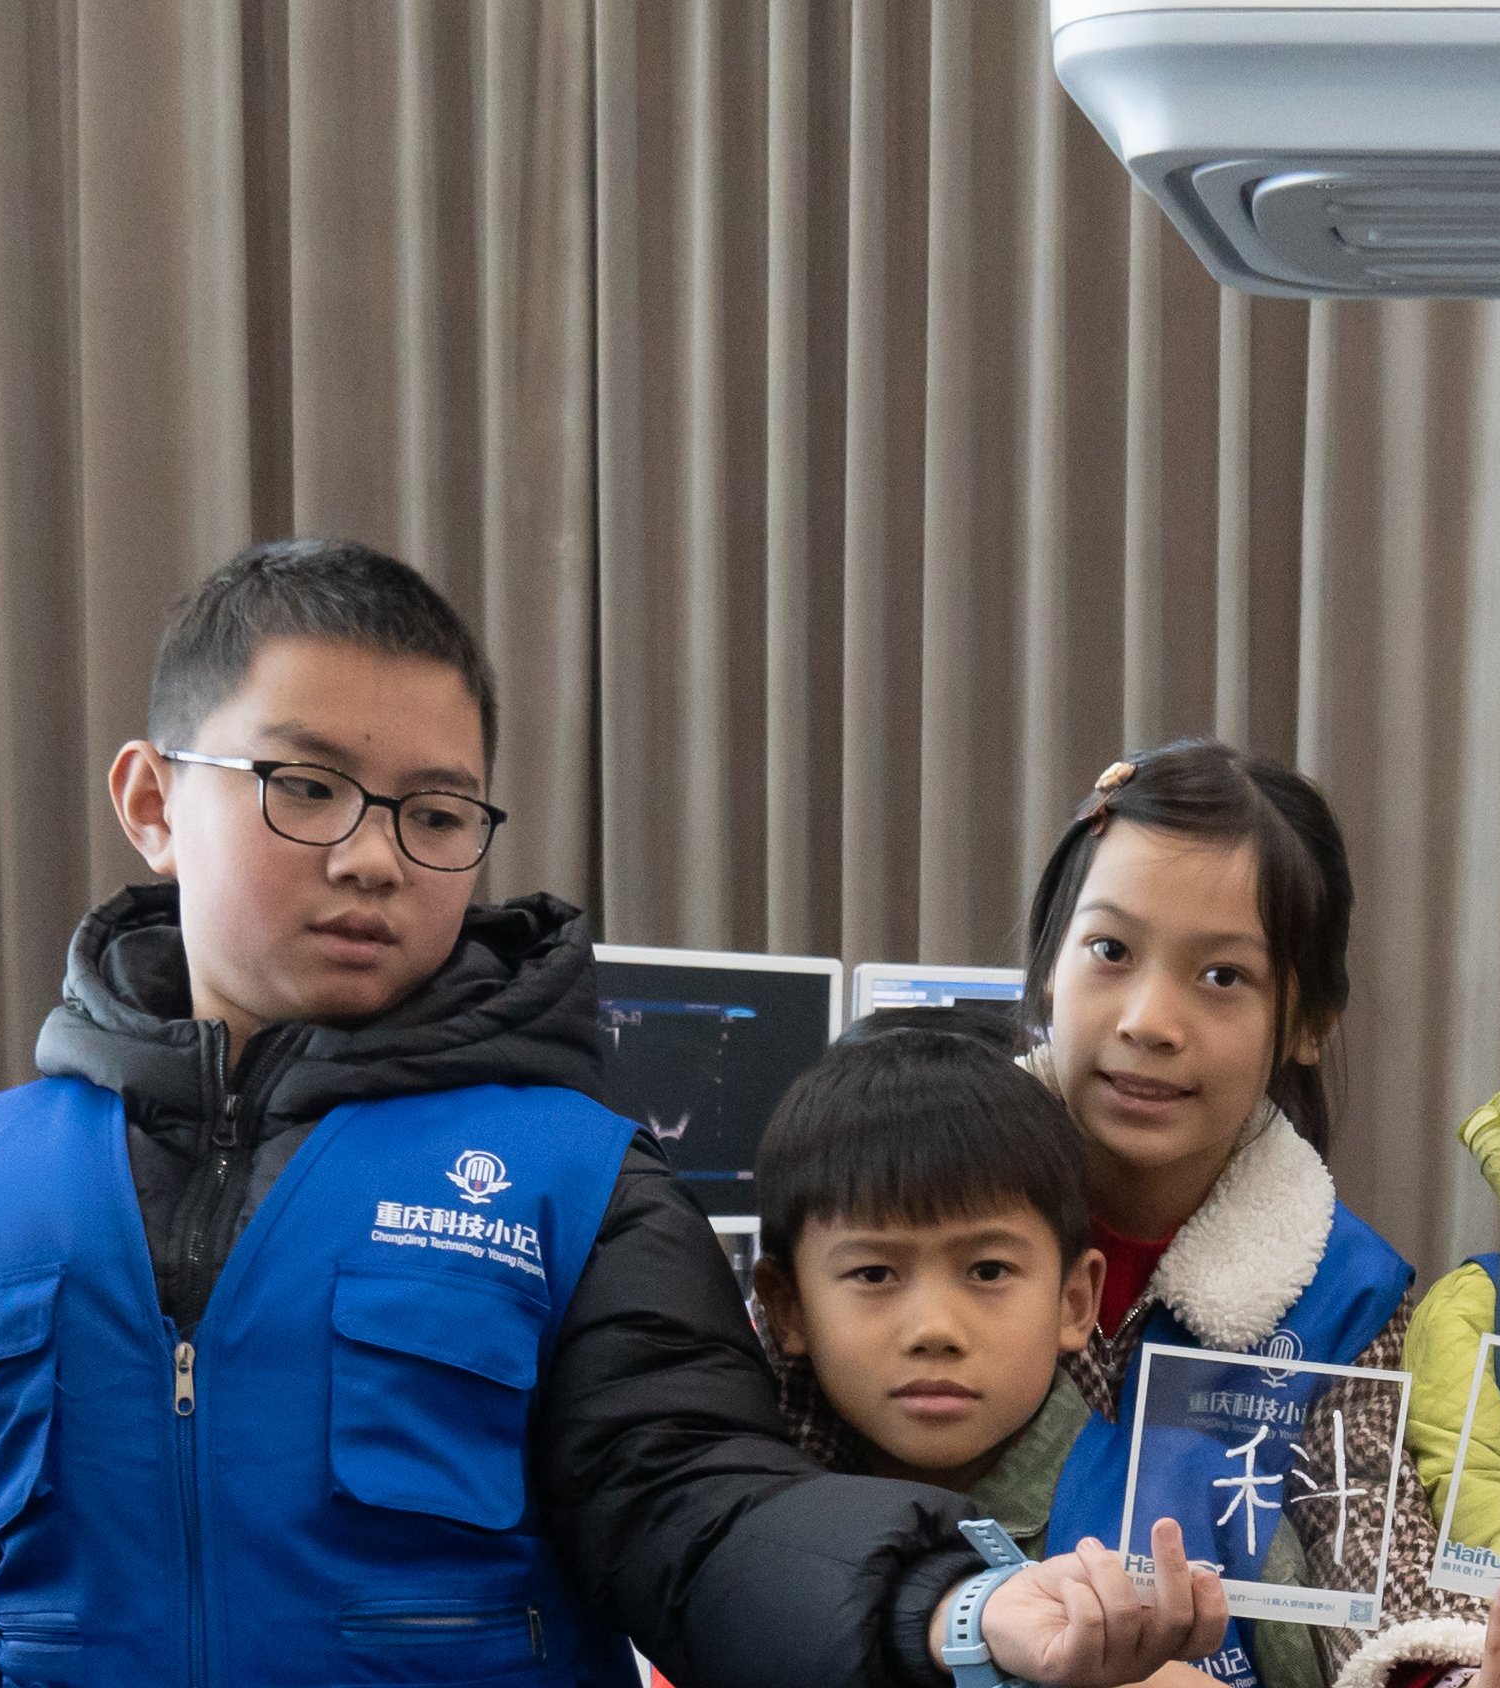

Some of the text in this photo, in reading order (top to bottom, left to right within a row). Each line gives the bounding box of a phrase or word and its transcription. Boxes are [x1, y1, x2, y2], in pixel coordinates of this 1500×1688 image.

[371, 1229, 427, 1248] ChongQing
[430, 1236, 486, 1258] Technology
[488, 1247, 517, 1268] Young
[374, 1200, 541, 1260] 重庆科技小记
[1188, 1390, 1307, 1426] 重庆科技小
[1212, 1409, 1367, 1566] 科
